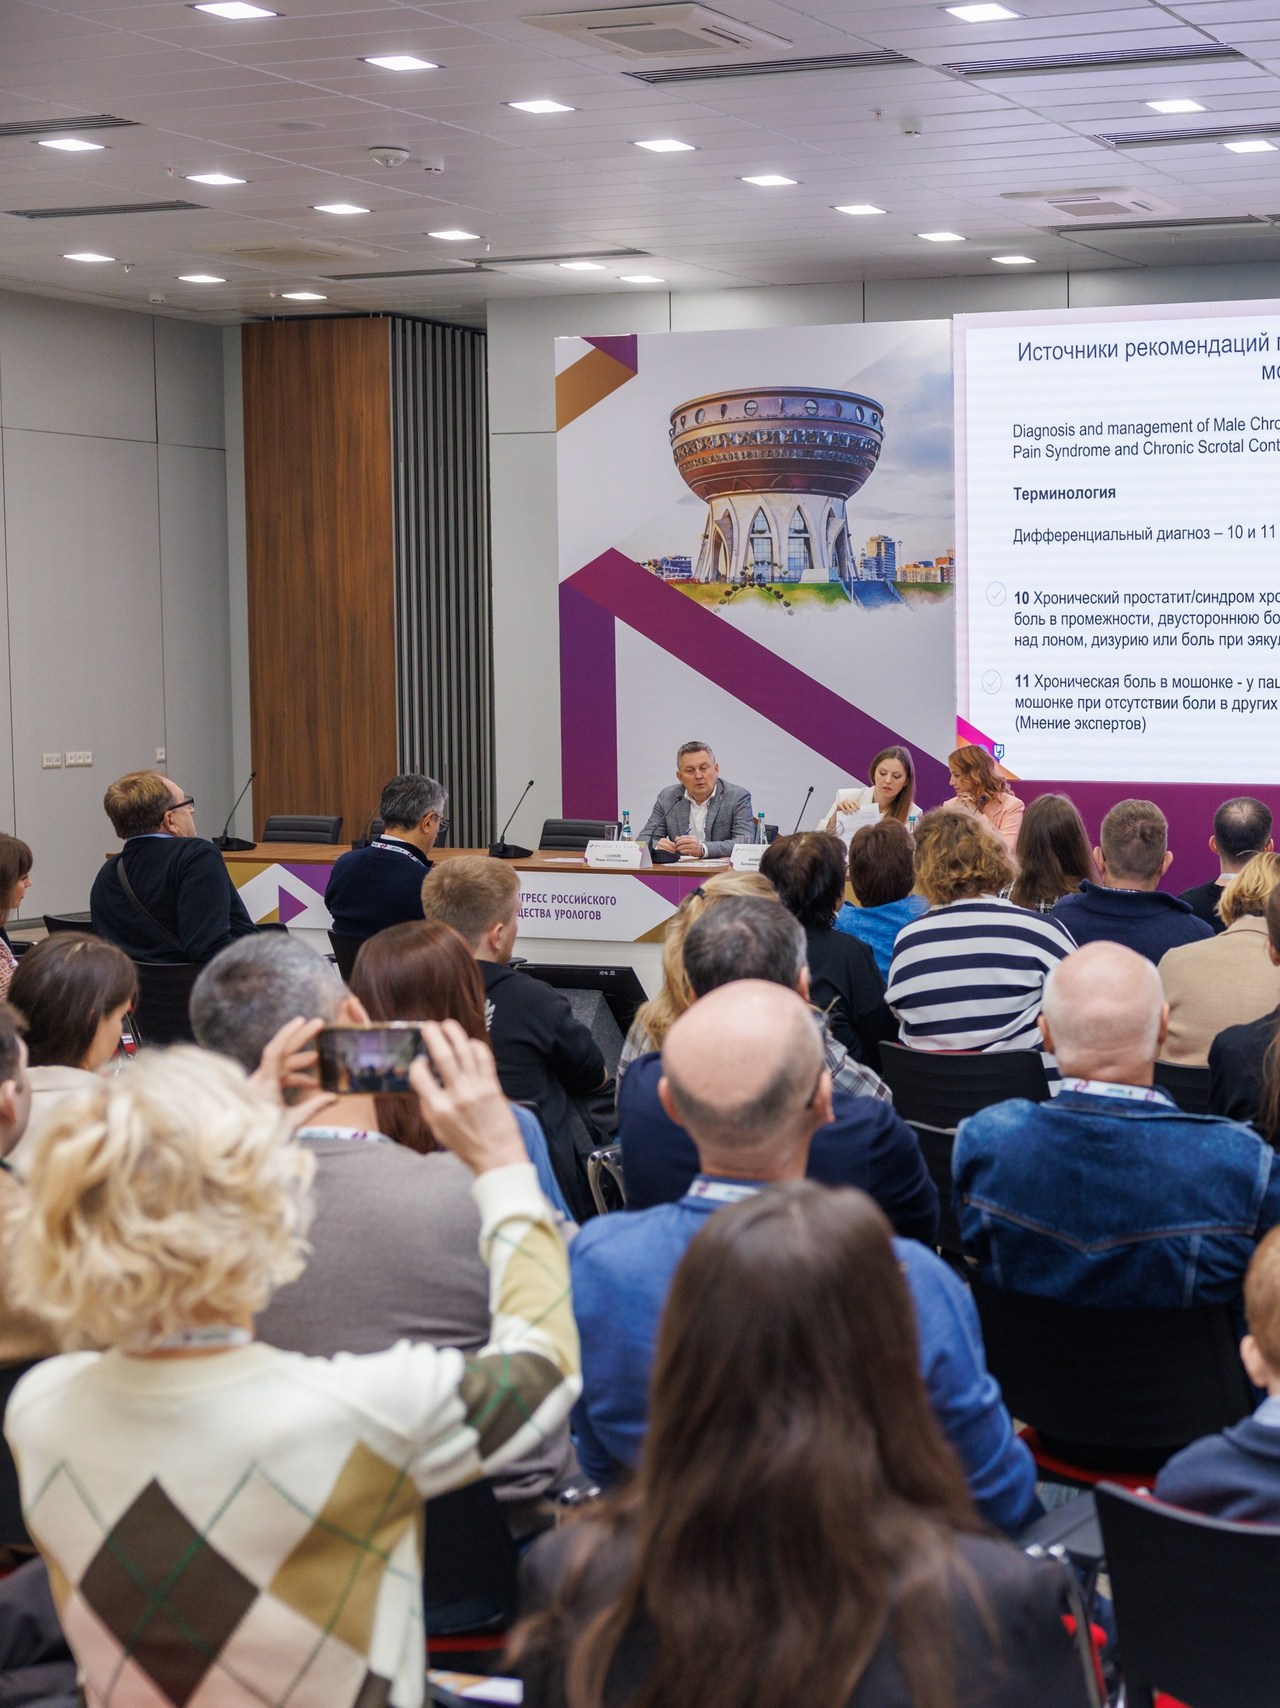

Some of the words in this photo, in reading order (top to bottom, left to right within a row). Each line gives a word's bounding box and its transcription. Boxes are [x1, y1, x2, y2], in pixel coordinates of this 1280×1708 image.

[1018, 341, 1118, 361] Источники
[1125, 331, 1269, 362] рекомендаций
[1013, 422, 1075, 441] Diagnosis
[1079, 421, 1103, 436] and
[1107, 419, 1193, 438] management
[1196, 417, 1210, 432] of
[1213, 416, 1246, 431] Male
[1013, 444, 1041, 459] Pain
[1045, 443, 1110, 461] Syndrome
[1114, 441, 1138, 456] and
[1142, 439, 1194, 455] Chronic
[1197, 438, 1244, 454] Scrotal
[1013, 486, 1116, 503] Терминология
[1012, 526, 1152, 545] Дифференциальный
[1156, 528, 1210, 542] диагноз
[1227, 524, 1243, 539] 10
[1247, 527, 1255, 538] и
[1260, 523, 1274, 538] 11
[1014, 590, 1029, 605] 10
[1033, 590, 1119, 608] Хронический
[1123, 589, 1254, 607] простатит/синдром
[1013, 611, 1046, 626] боль
[1049, 614, 1057, 625] в
[1060, 614, 1153, 629] промежности,
[1157, 613, 1259, 628] двустороннюю
[1014, 635, 1038, 648] над
[1041, 635, 1087, 648] лоном,
[1090, 635, 1149, 650] дизурию
[1152, 635, 1177, 646] или
[1181, 631, 1215, 646] боль
[1218, 634, 1243, 649] при
[1014, 673, 1029, 688] 11
[1033, 673, 1119, 691] Хроническая
[1123, 673, 1156, 688] боль
[1160, 677, 1168, 688] в
[1171, 677, 1233, 689] мошонке
[1245, 677, 1254, 692] у
[1014, 697, 1073, 709] мошонке
[1077, 697, 1101, 712] при
[1104, 697, 1178, 713] отсутствии
[1182, 695, 1216, 710] боли
[1220, 698, 1228, 710] в
[1231, 698, 1278, 713] других
[1015, 714, 1070, 732] (Мнение
[1074, 715, 1146, 733] экспертов)
[519, 893, 548, 904] ГРЕСС
[551, 892, 617, 906] РОССИЙСКОГО
[518, 908, 551, 919] ЩЕСТВА
[555, 909, 602, 921] УРОЛОГОВ
